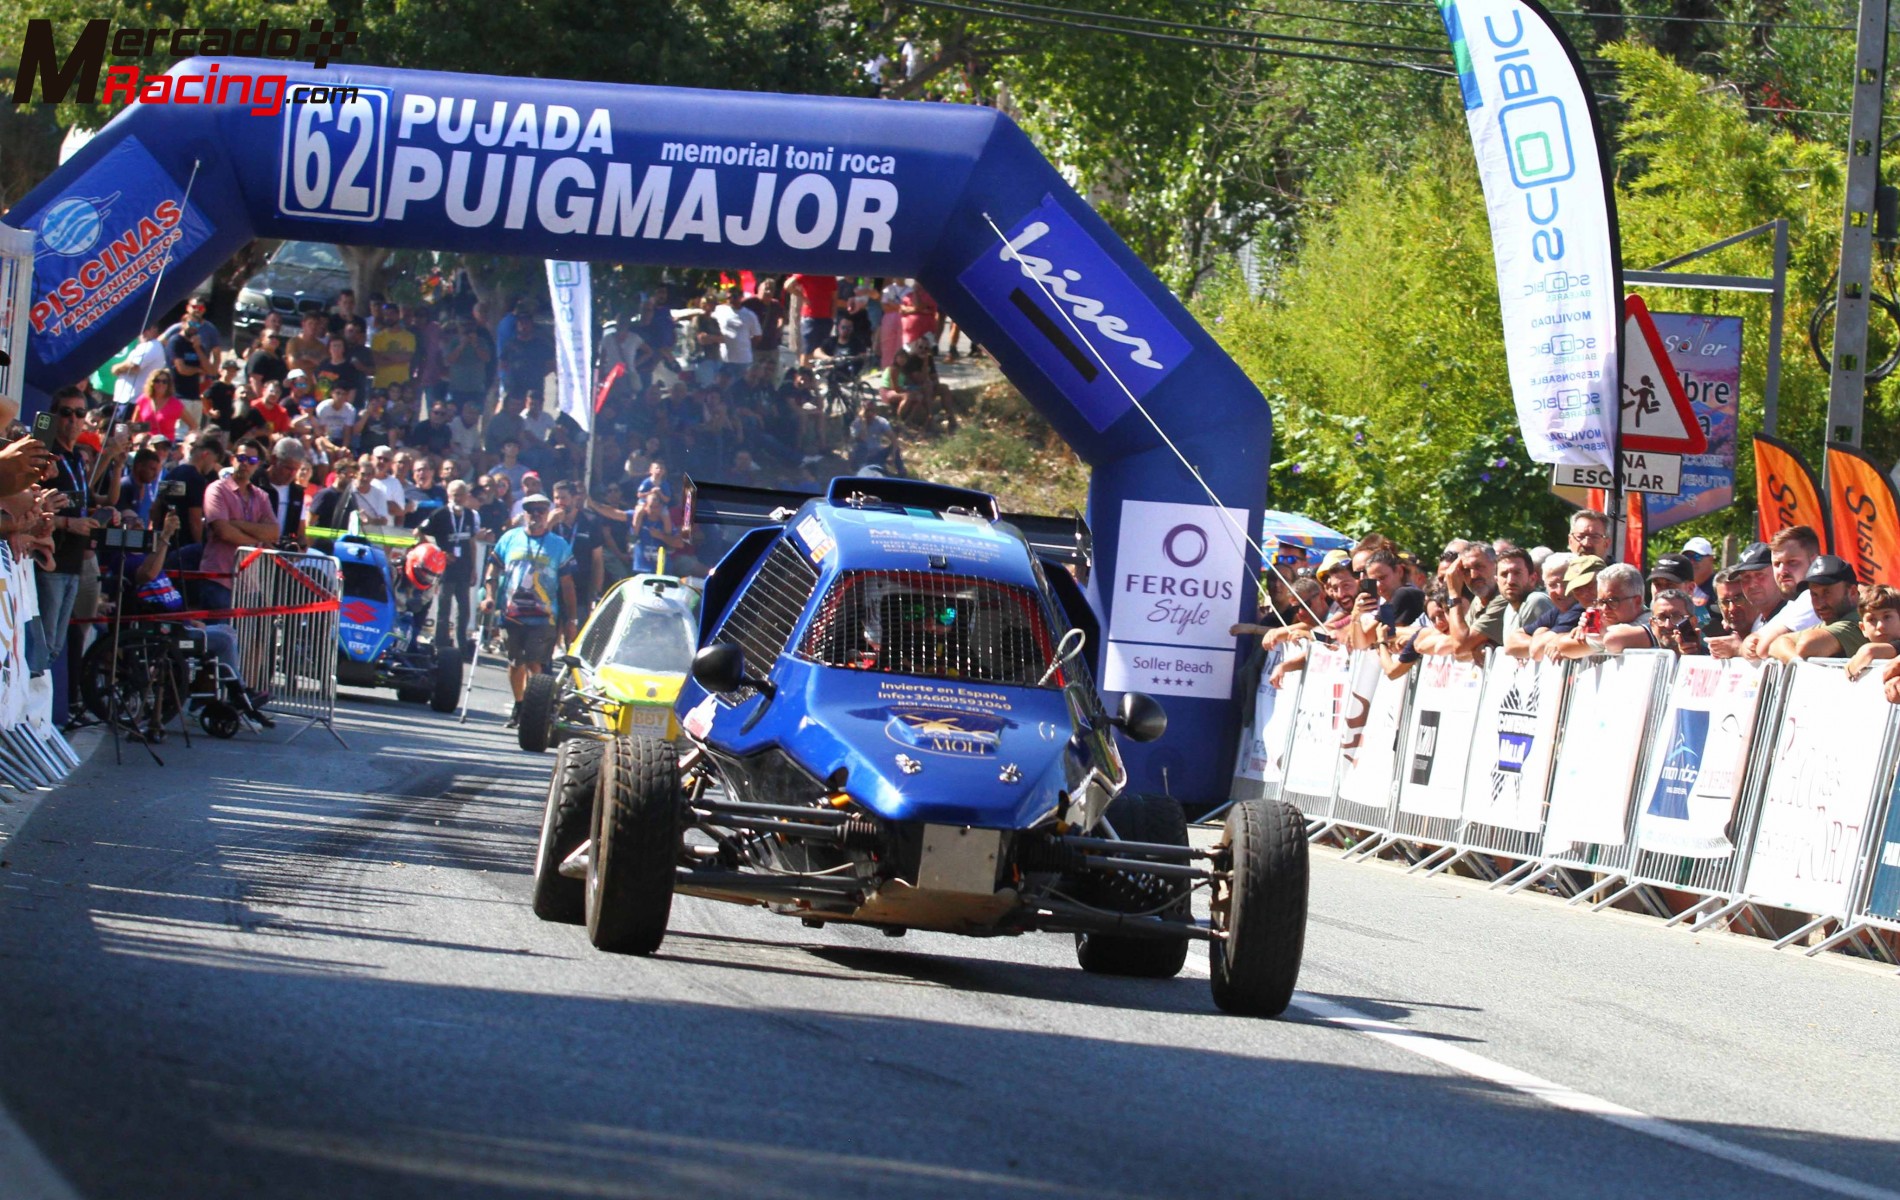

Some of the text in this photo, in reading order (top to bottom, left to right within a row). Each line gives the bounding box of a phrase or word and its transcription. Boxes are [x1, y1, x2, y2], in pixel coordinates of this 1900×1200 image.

[399, 94, 614, 156] PUJADA
[293, 96, 375, 213] 62
[661, 137, 896, 176] memorial toni roca
[384, 146, 899, 253] PUIGMAJOR
[29, 199, 182, 335] PISCINAS
[50, 321, 62, 337] Y
[61, 227, 183, 329] MANTENIMIENTOS
[75, 272, 149, 334] MALLORCA
[1675, 371, 1731, 405] bre
[1767, 474, 1799, 530] Su
[1125, 574, 1234, 601] FERGUS
[1147, 598, 1210, 636] Style
[880, 681, 1007, 702] Invierte en España
[1132, 656, 1214, 675] Soller Beach
